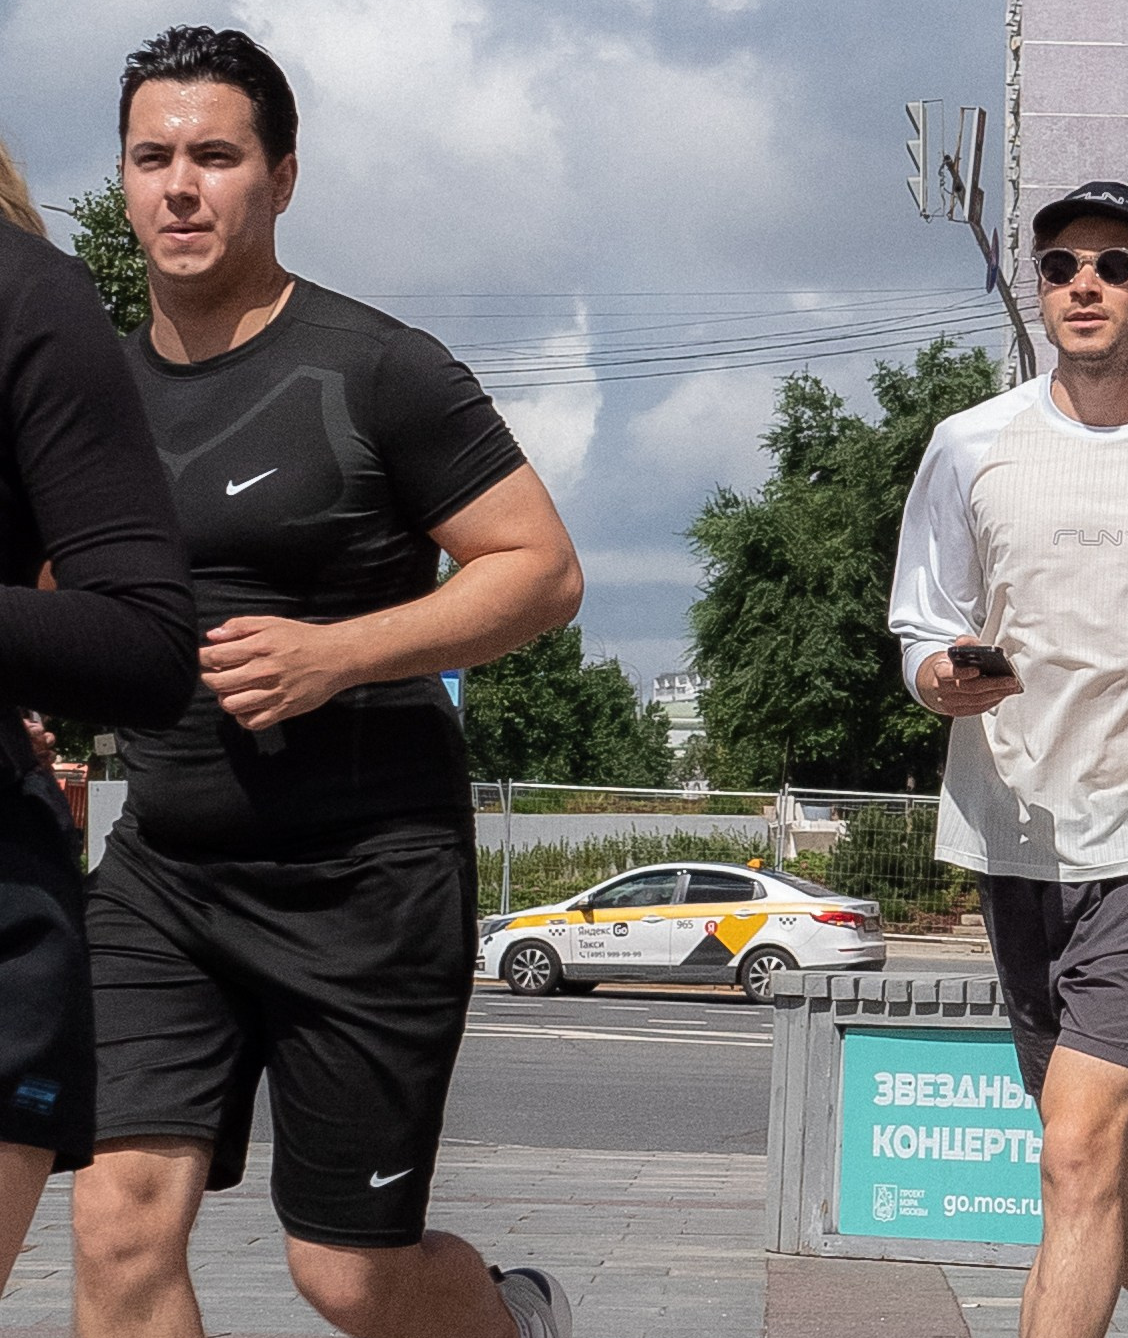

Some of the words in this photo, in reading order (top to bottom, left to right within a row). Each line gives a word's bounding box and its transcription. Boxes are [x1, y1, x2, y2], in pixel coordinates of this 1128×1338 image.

[676, 920, 694, 930] 965
[578, 926, 611, 937] Яндекс
[580, 939, 605, 949] Такси
[873, 1071, 1033, 1110] ЗВЕЗДНЫ
[943, 1194, 1043, 1217] go.mos.ru
